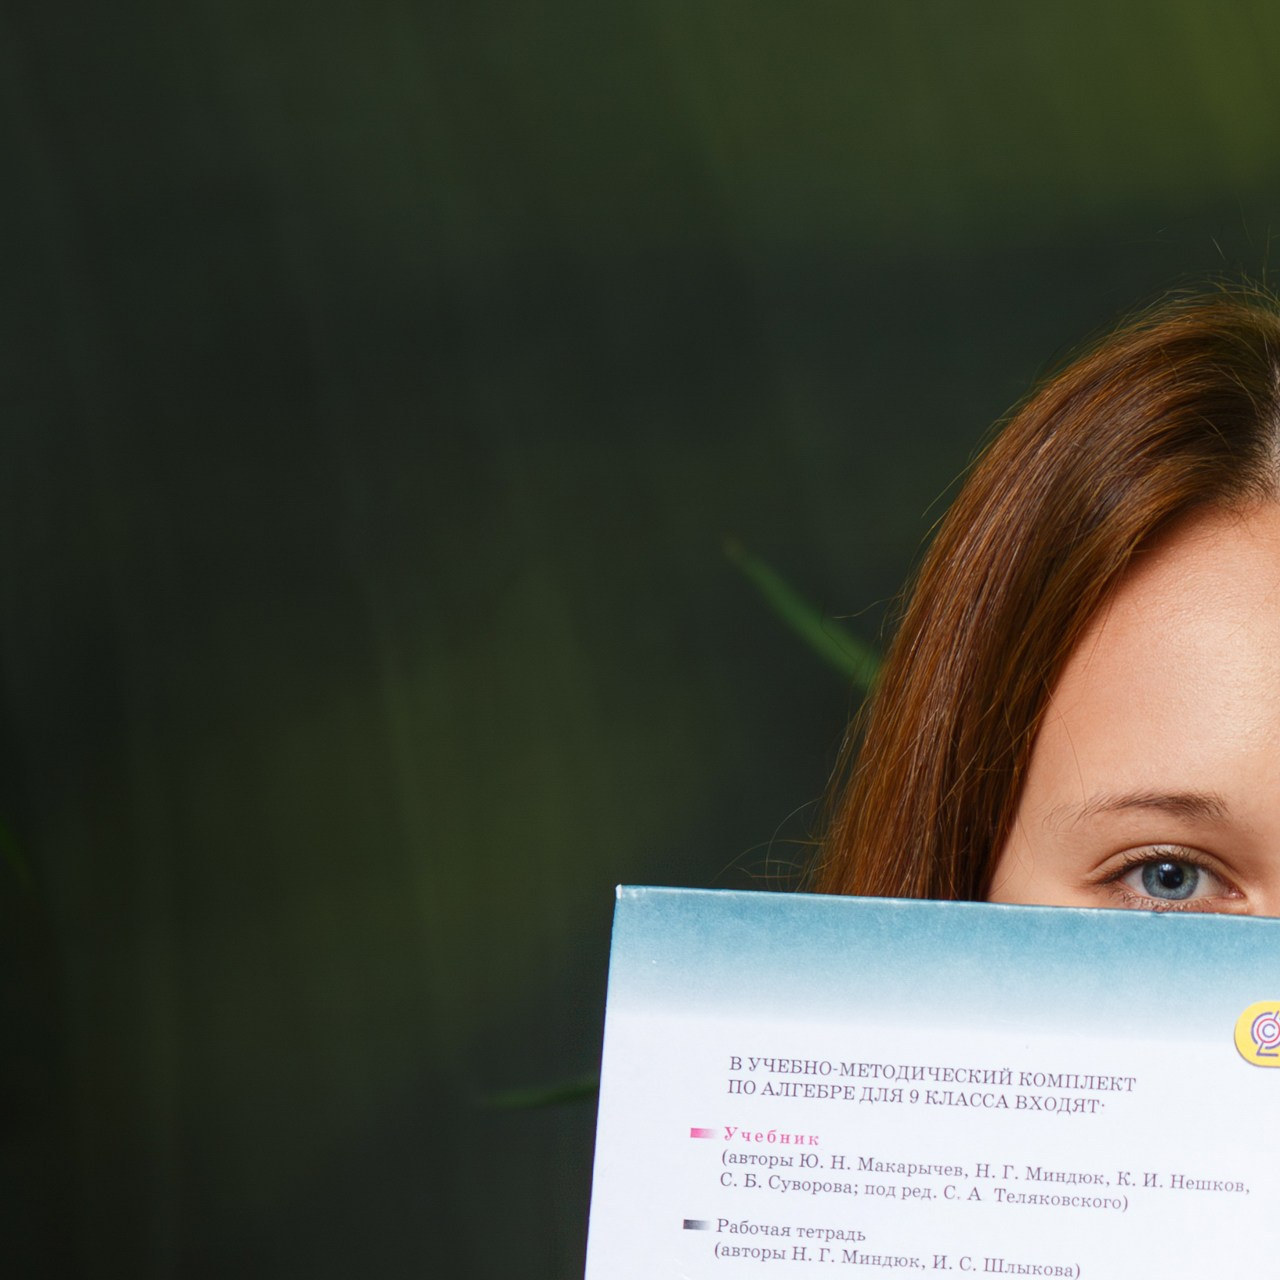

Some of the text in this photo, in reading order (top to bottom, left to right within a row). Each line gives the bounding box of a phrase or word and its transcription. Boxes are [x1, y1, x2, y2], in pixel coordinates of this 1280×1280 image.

[728, 1055, 1137, 1092] В УЧЕБНО-МЕТОДИЧЕСКИЙ КОМПЛЕКТ
[727, 1079, 757, 1096] ПО
[759, 1081, 856, 1101] АЛГЕБРЕ
[858, 1086, 905, 1105] ДЛЯ
[909, 1088, 920, 1105] 9
[924, 1089, 1010, 1109] КЛАССА
[723, 1125, 820, 1146] Учебник
[721, 1149, 1250, 1195] (авторы Ю. Н. Макарычев, Н. Г. Миндюк, К. И. Нешков,
[719, 1171, 738, 1188] С.
[743, 1173, 762, 1189] Б.
[767, 1174, 859, 1197] Суворова;
[864, 1184, 897, 1199] под
[901, 1186, 937, 1201] ред.
[943, 1184, 961, 1201] С.
[993, 1187, 1129, 1213] Теляковского)
[715, 1217, 867, 1243] Рабочая тетрадь
[714, 1241, 1081, 1280] (авторы Н. Г. Миндюк, И. С. Шлыкова)
